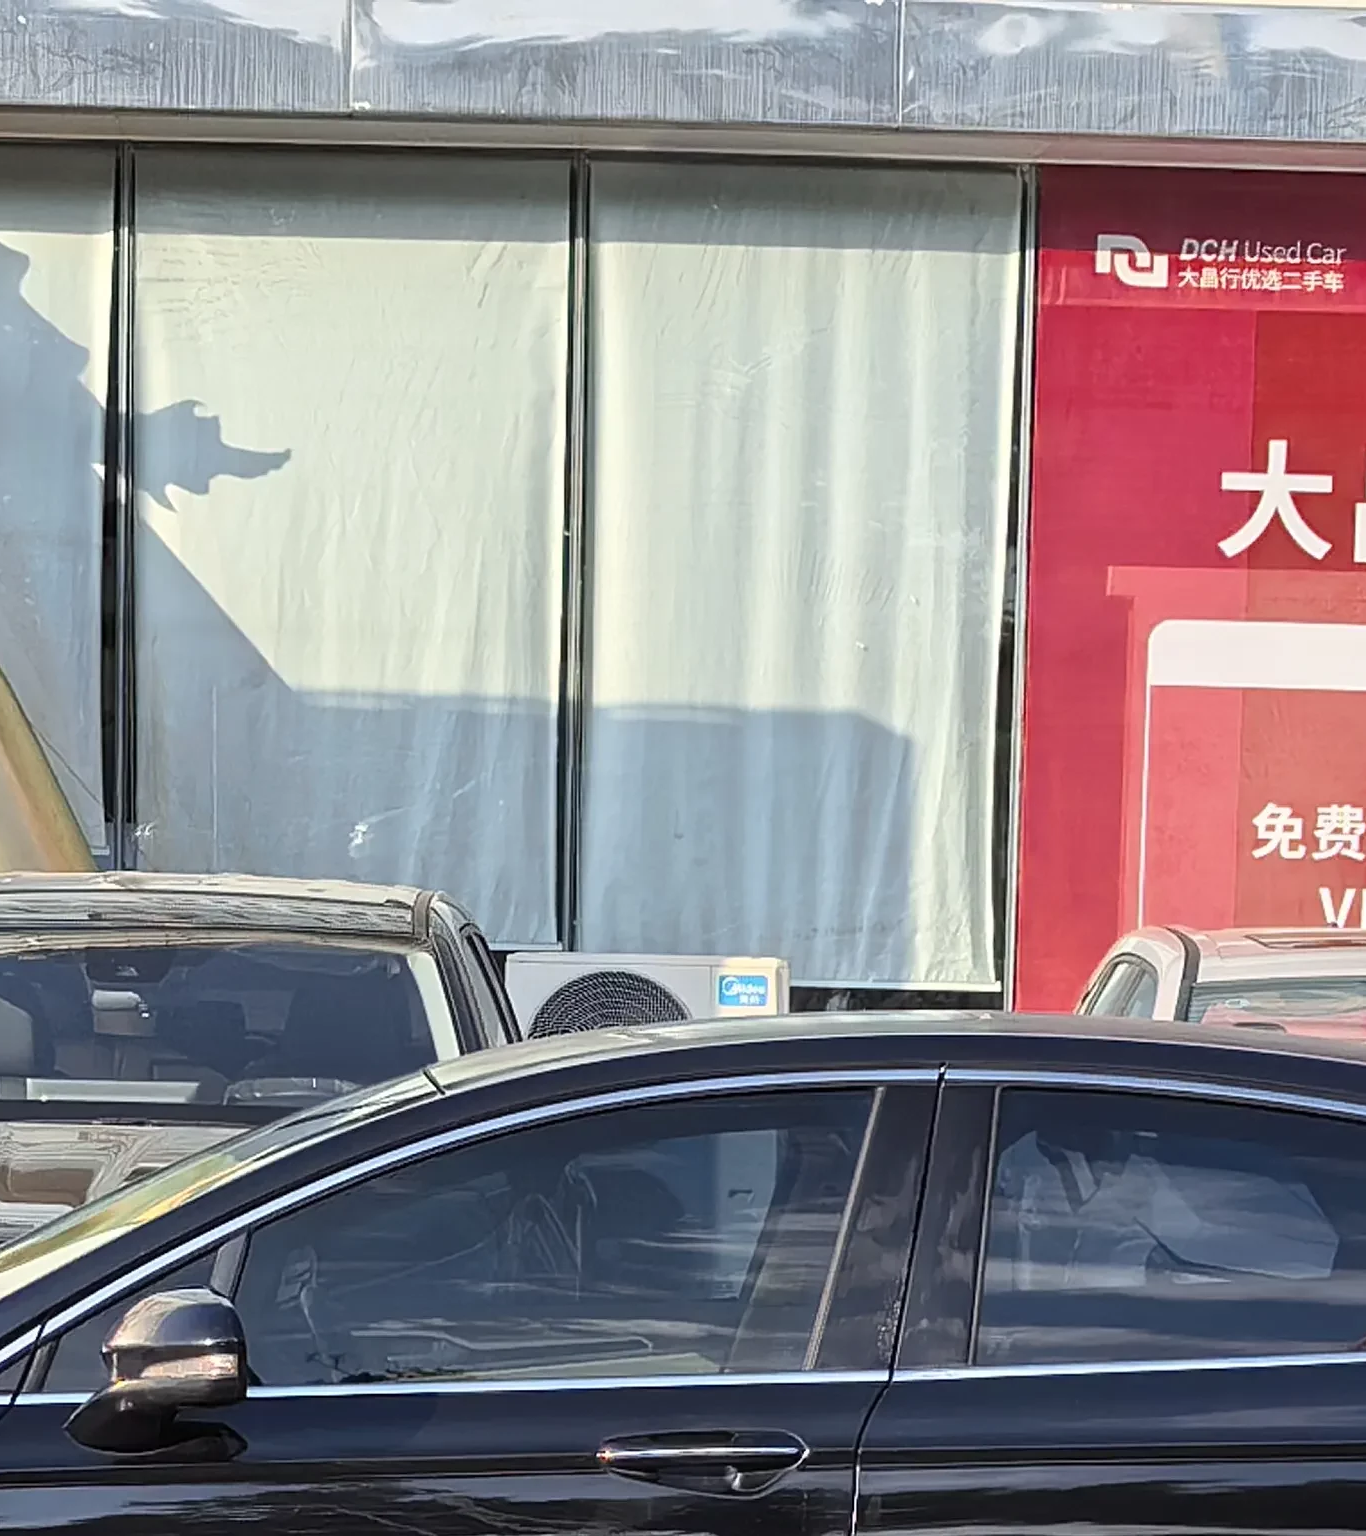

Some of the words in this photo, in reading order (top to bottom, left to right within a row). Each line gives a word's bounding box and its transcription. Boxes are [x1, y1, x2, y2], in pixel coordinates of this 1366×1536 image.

[1179, 238, 1238, 262] DCH
[1244, 240, 1301, 264] Used
[1306, 243, 1346, 265] Car
[1178, 266, 1344, 293] 大昌行优选二手车
